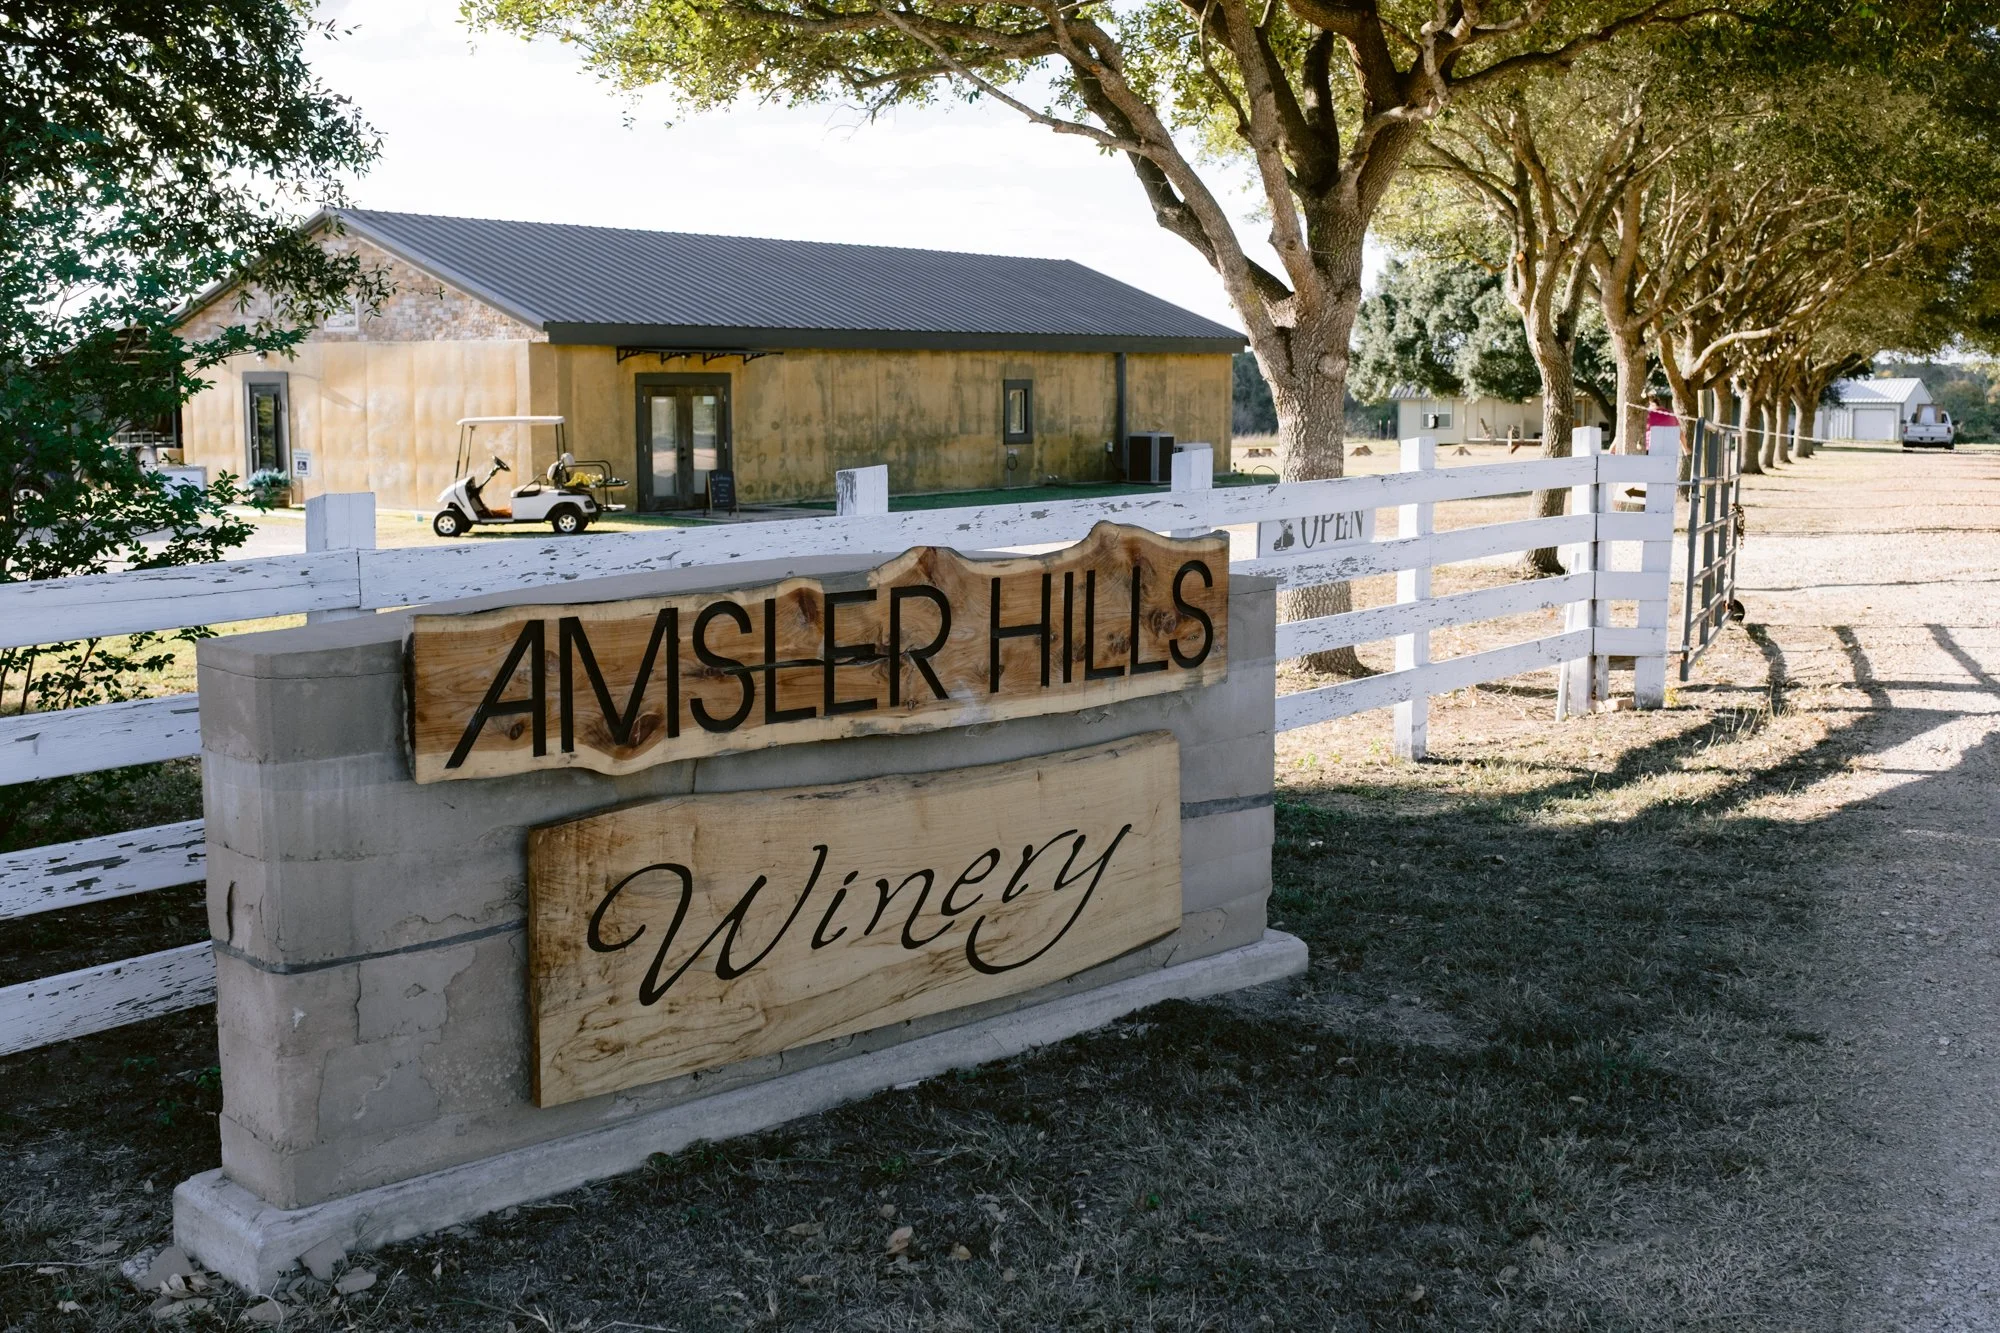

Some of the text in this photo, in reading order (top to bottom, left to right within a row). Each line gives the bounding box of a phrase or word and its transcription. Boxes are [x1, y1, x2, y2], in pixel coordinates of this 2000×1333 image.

[1301, 510, 1364, 549] OPEN
[445, 560, 1214, 769] AMSLER HILLS
[587, 823, 1132, 1006] Winery
